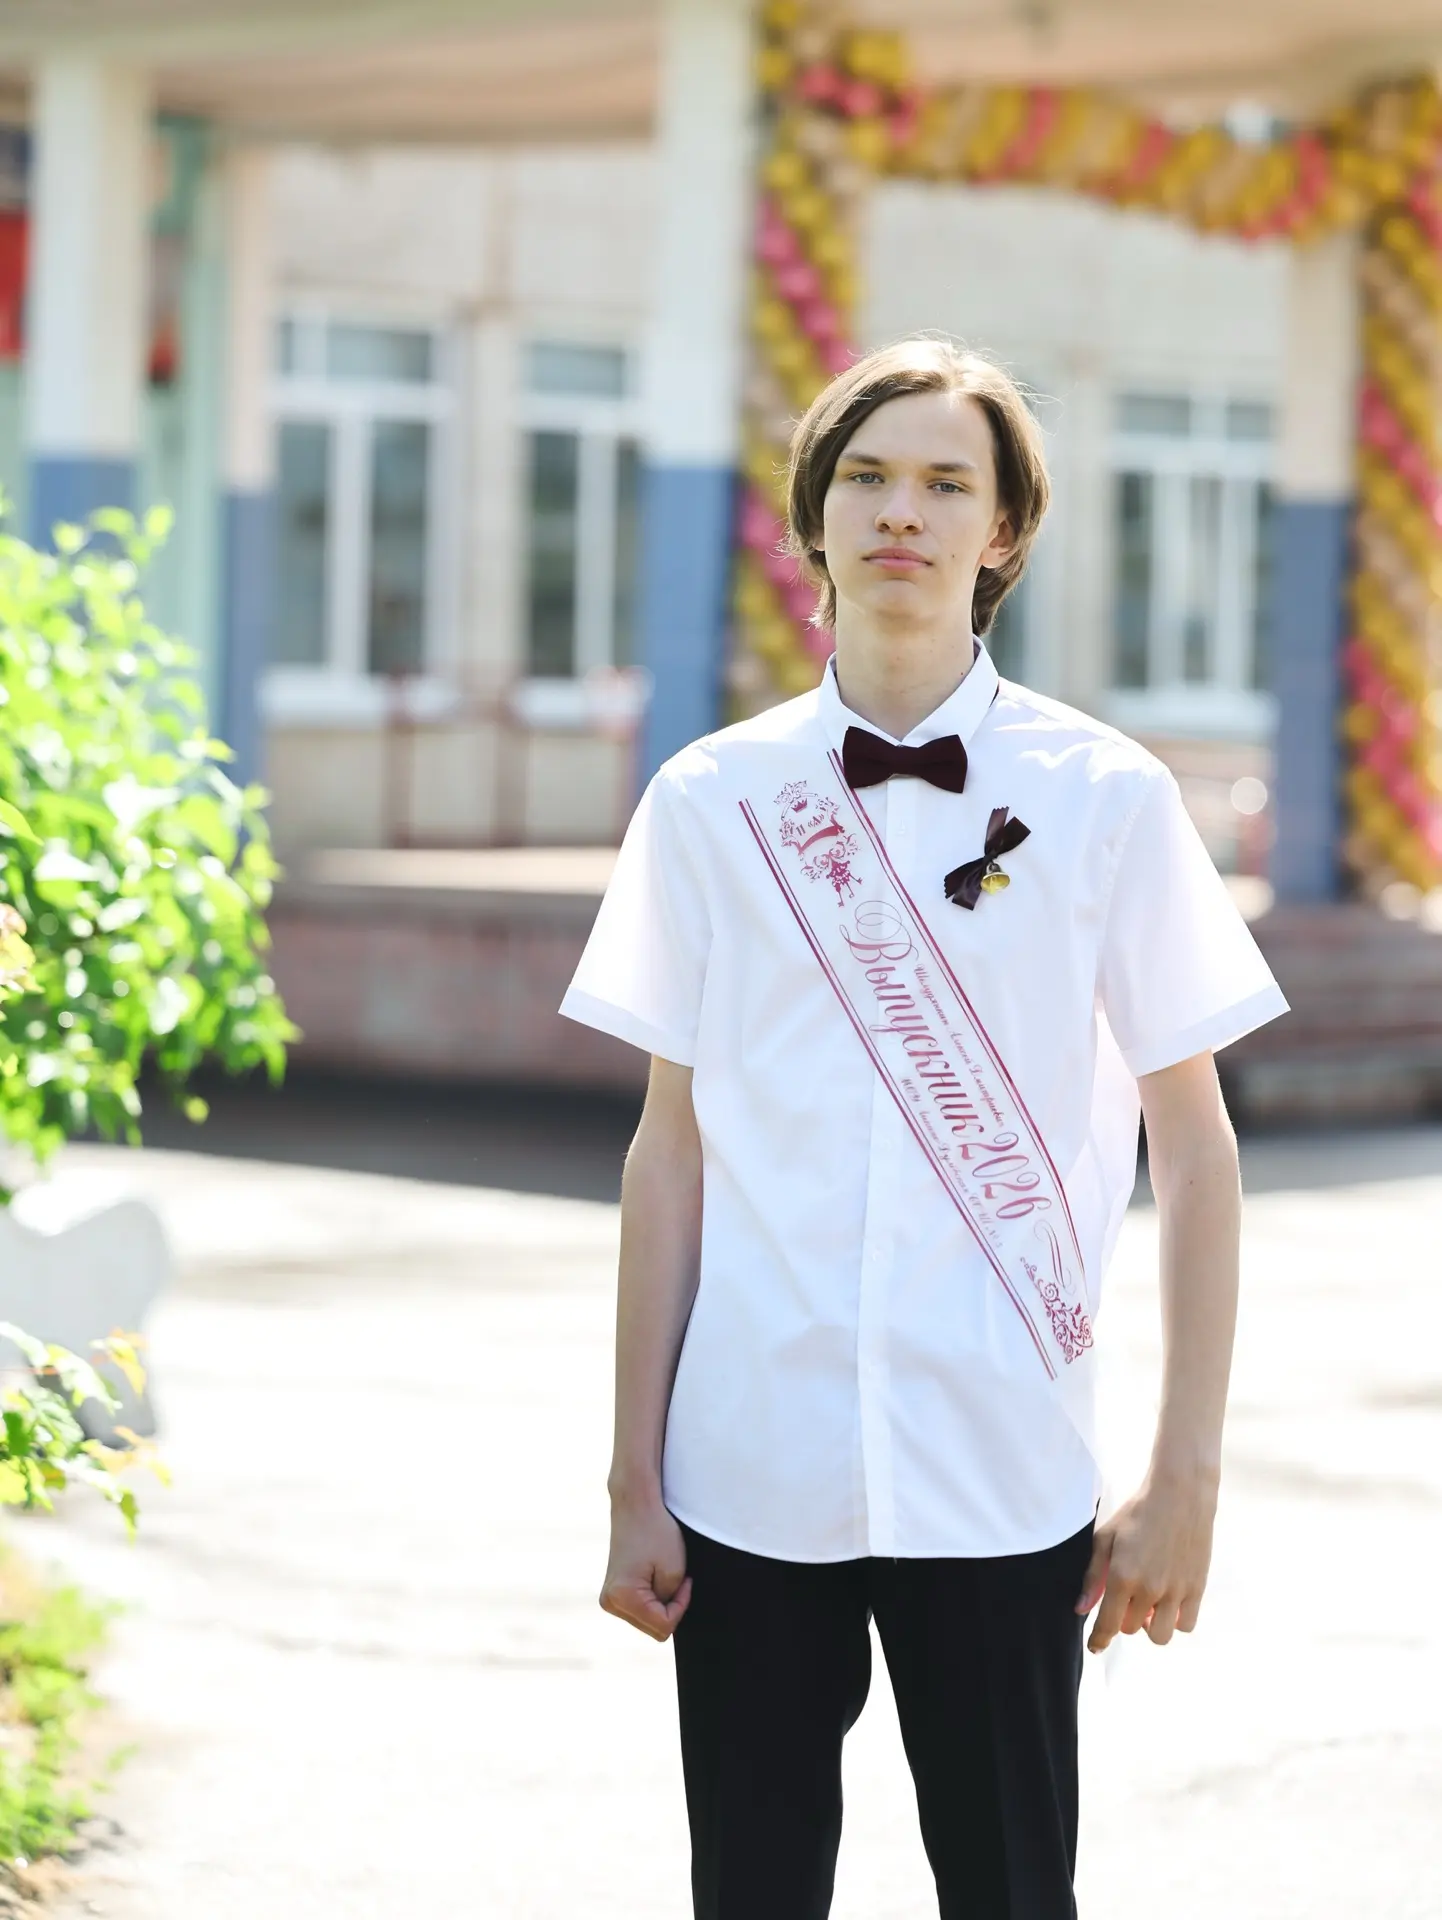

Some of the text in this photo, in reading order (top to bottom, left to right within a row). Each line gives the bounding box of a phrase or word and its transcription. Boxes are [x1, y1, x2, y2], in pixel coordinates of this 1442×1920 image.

[839, 900, 1052, 1219] Выпускник 2026
[947, 1026, 972, 1065] Алексей
[968, 1063, 1005, 1128] Дмитриевич
